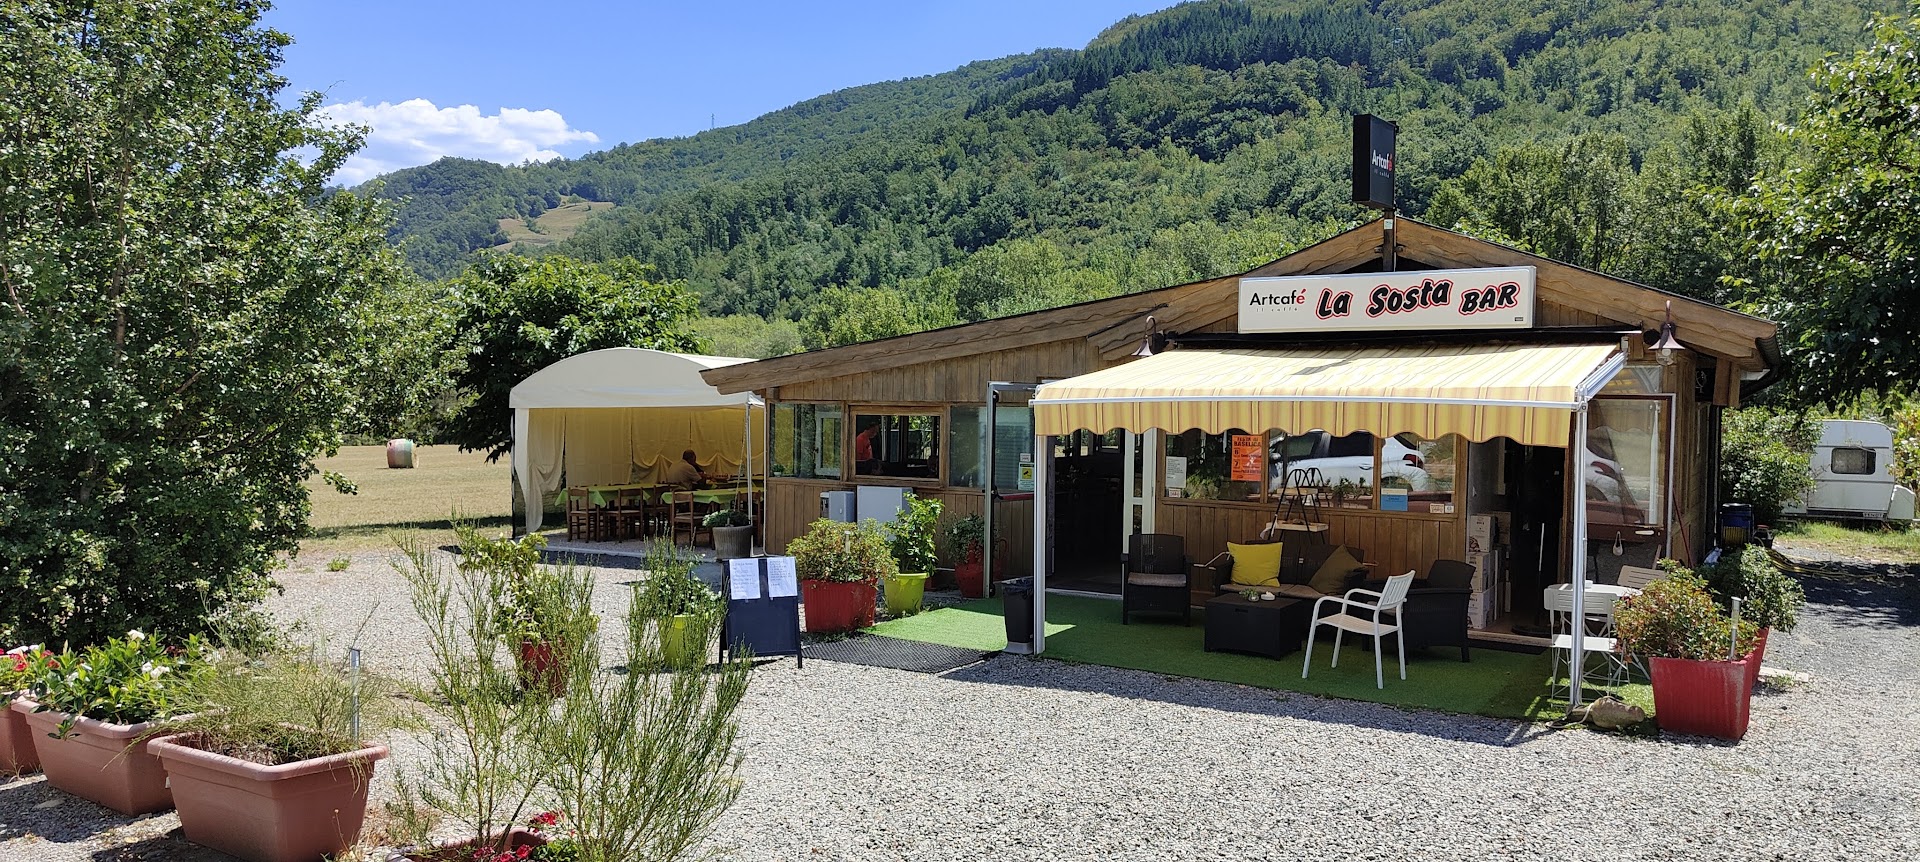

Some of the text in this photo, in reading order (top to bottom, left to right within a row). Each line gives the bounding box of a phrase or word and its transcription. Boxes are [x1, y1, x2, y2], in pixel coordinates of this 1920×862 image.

[1372, 149, 1392, 171] Artcafé
[1249, 288, 1307, 306] Artcafé
[1316, 278, 1520, 319] La Sosta BAR
